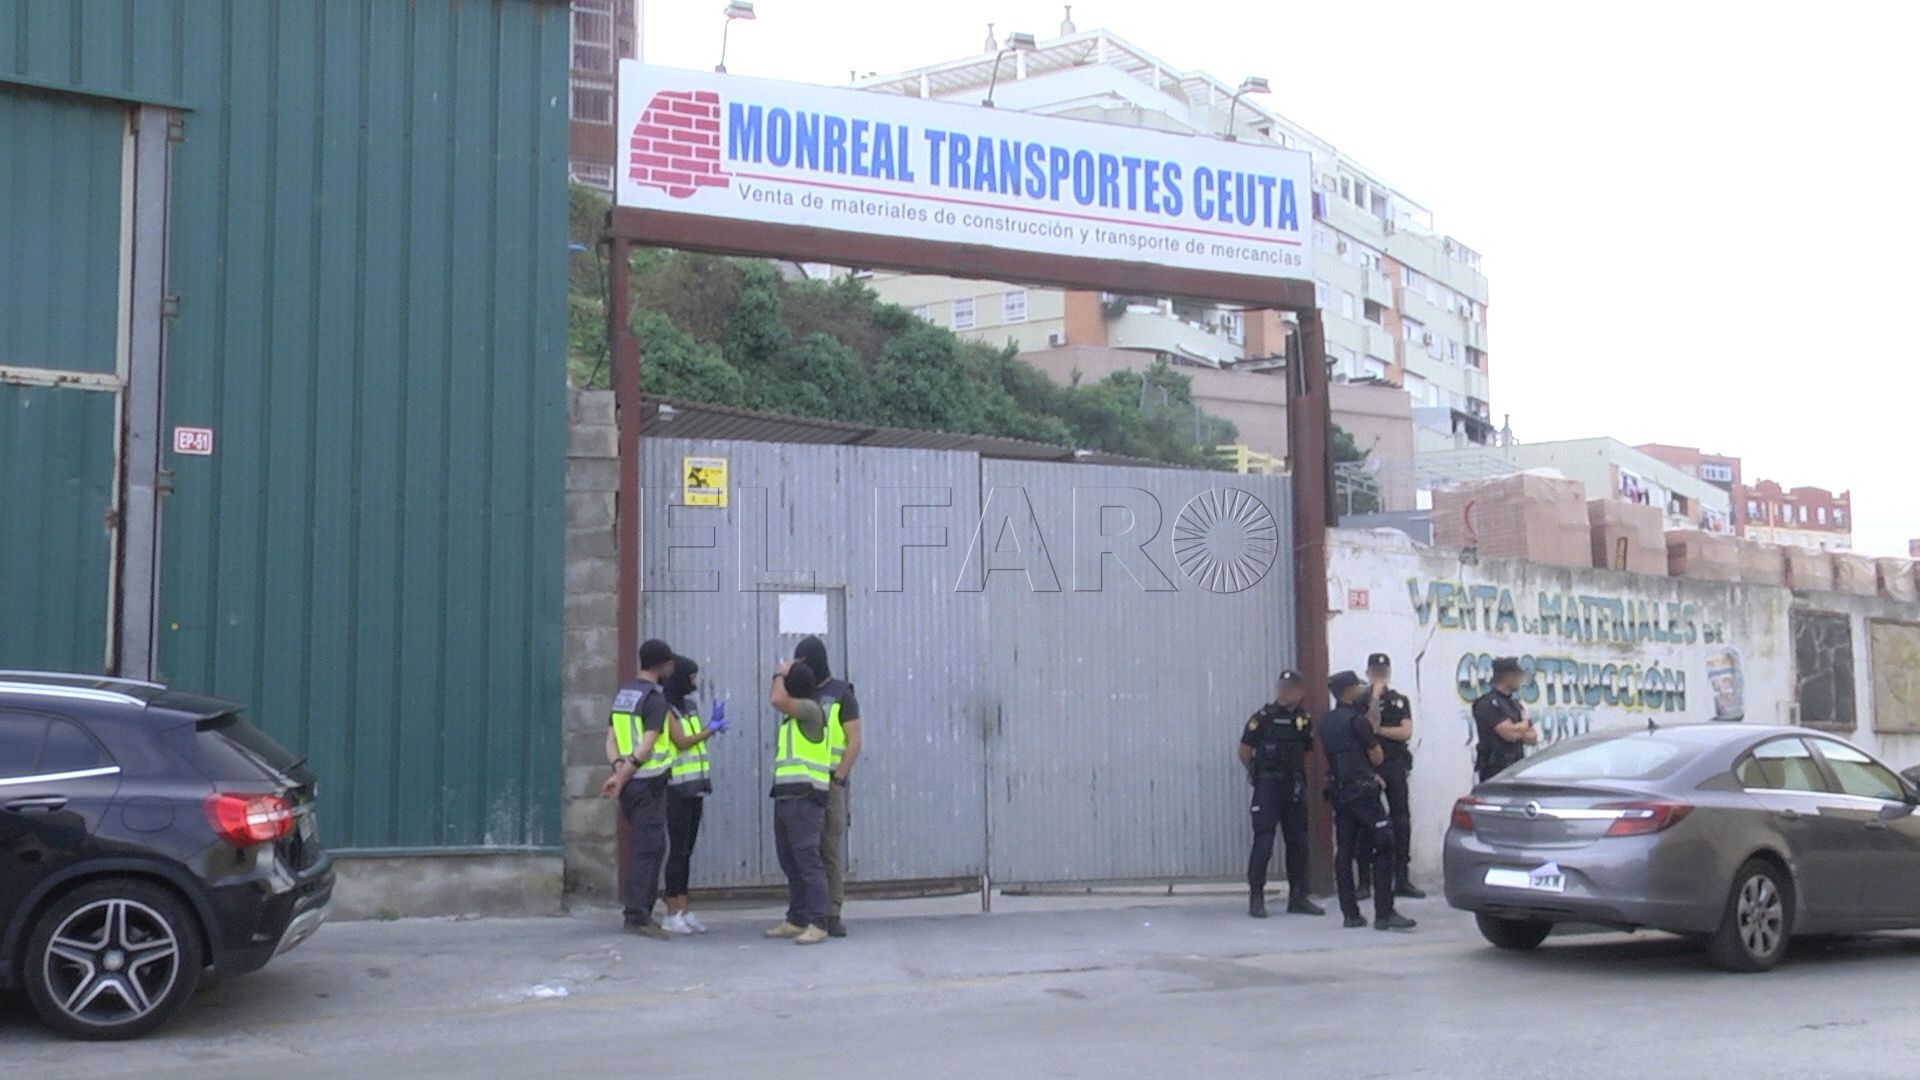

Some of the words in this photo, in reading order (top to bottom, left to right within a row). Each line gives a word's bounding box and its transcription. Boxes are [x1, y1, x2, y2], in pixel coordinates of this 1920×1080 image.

[728, 102, 914, 183] MONREAL
[924, 128, 1184, 217] TRANSPORTES
[1193, 166, 1299, 232] CEUTA
[738, 183, 794, 206] Venta
[801, 189, 824, 210] de
[831, 196, 928, 222] materiales
[934, 208, 956, 226] de
[963, 213, 1074, 239] construcción
[1079, 228, 1089, 244] y
[1095, 227, 1179, 252] transporte
[1185, 237, 1205, 255] de
[1211, 242, 1302, 267] mercancías
[1406, 577, 1519, 633] VENTA
[1538, 590, 1698, 645] MATERIALES
[1703, 622, 1725, 644] DE
[1456, 652, 1686, 713] COSTRUCCIÓN
